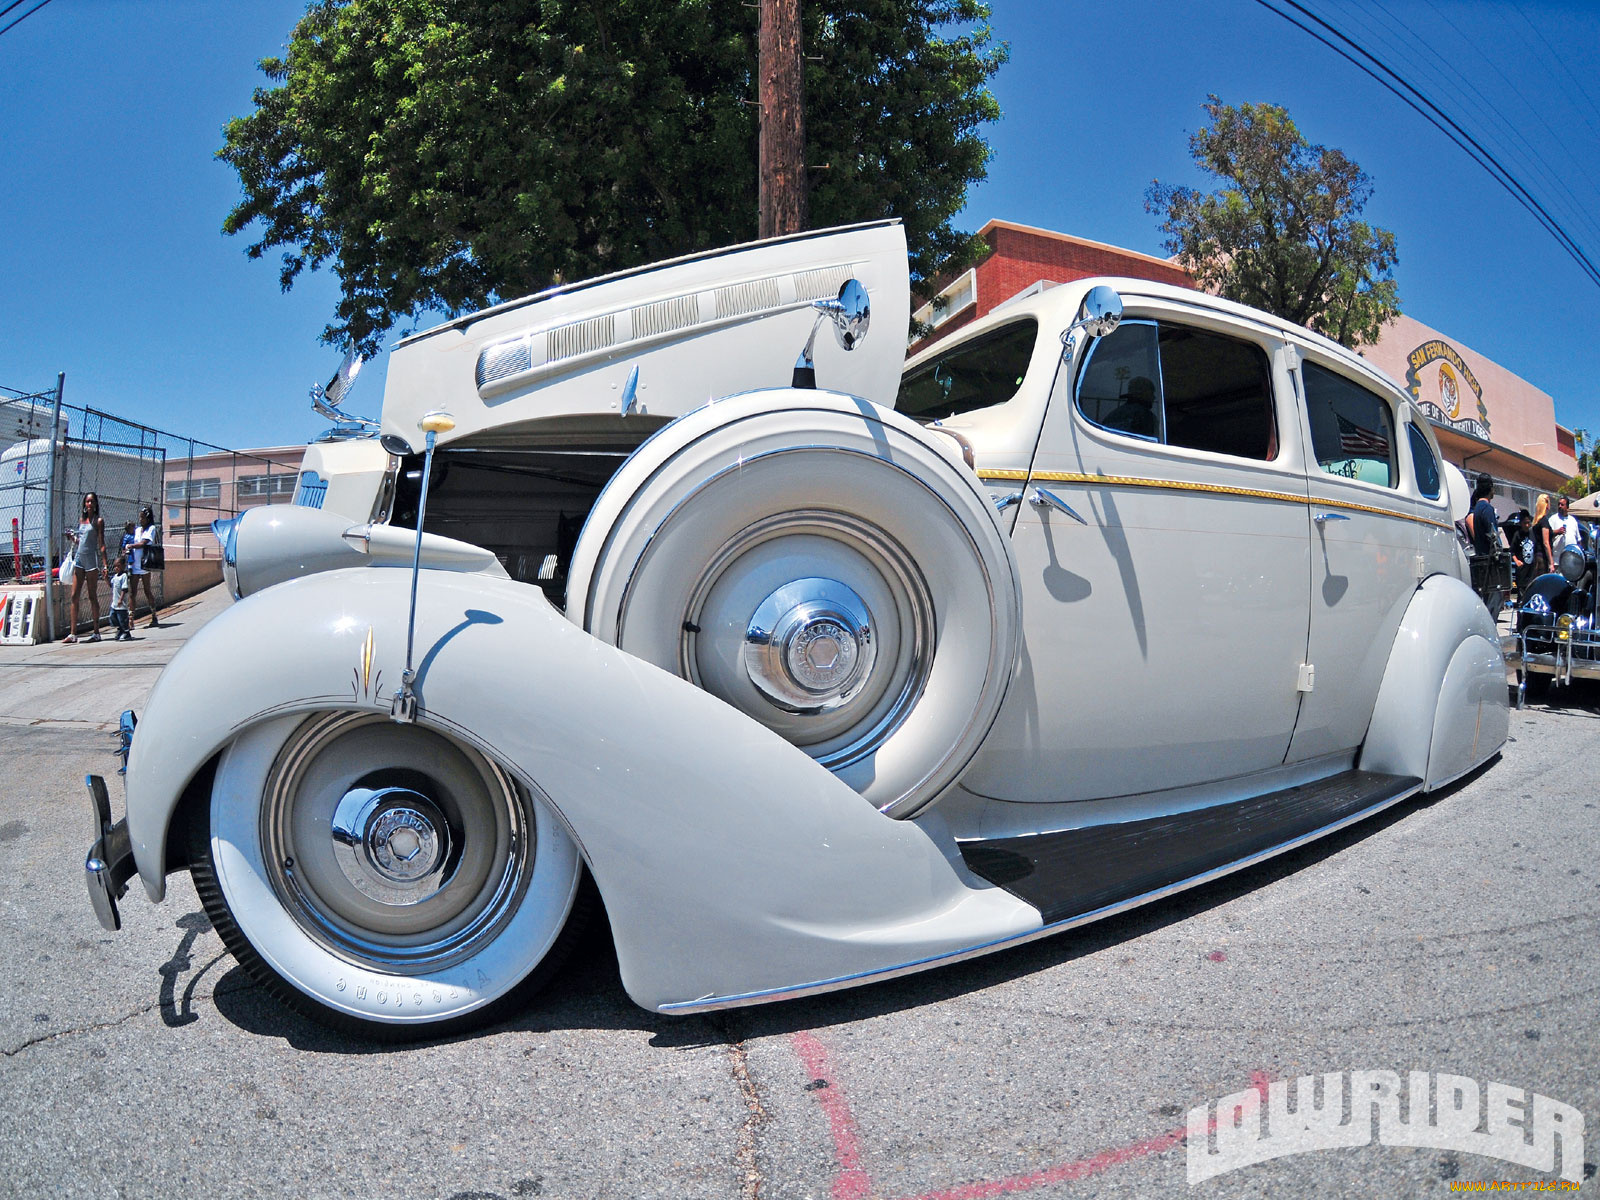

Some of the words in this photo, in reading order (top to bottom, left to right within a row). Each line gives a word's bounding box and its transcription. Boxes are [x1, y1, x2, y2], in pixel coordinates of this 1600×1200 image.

[1411, 348, 1427, 368] SAN
[1425, 342, 1463, 370] FERNANDO
[1463, 365, 1480, 395] HIGH
[1432, 405, 1439, 419] OF
[1440, 411, 1452, 427] THE
